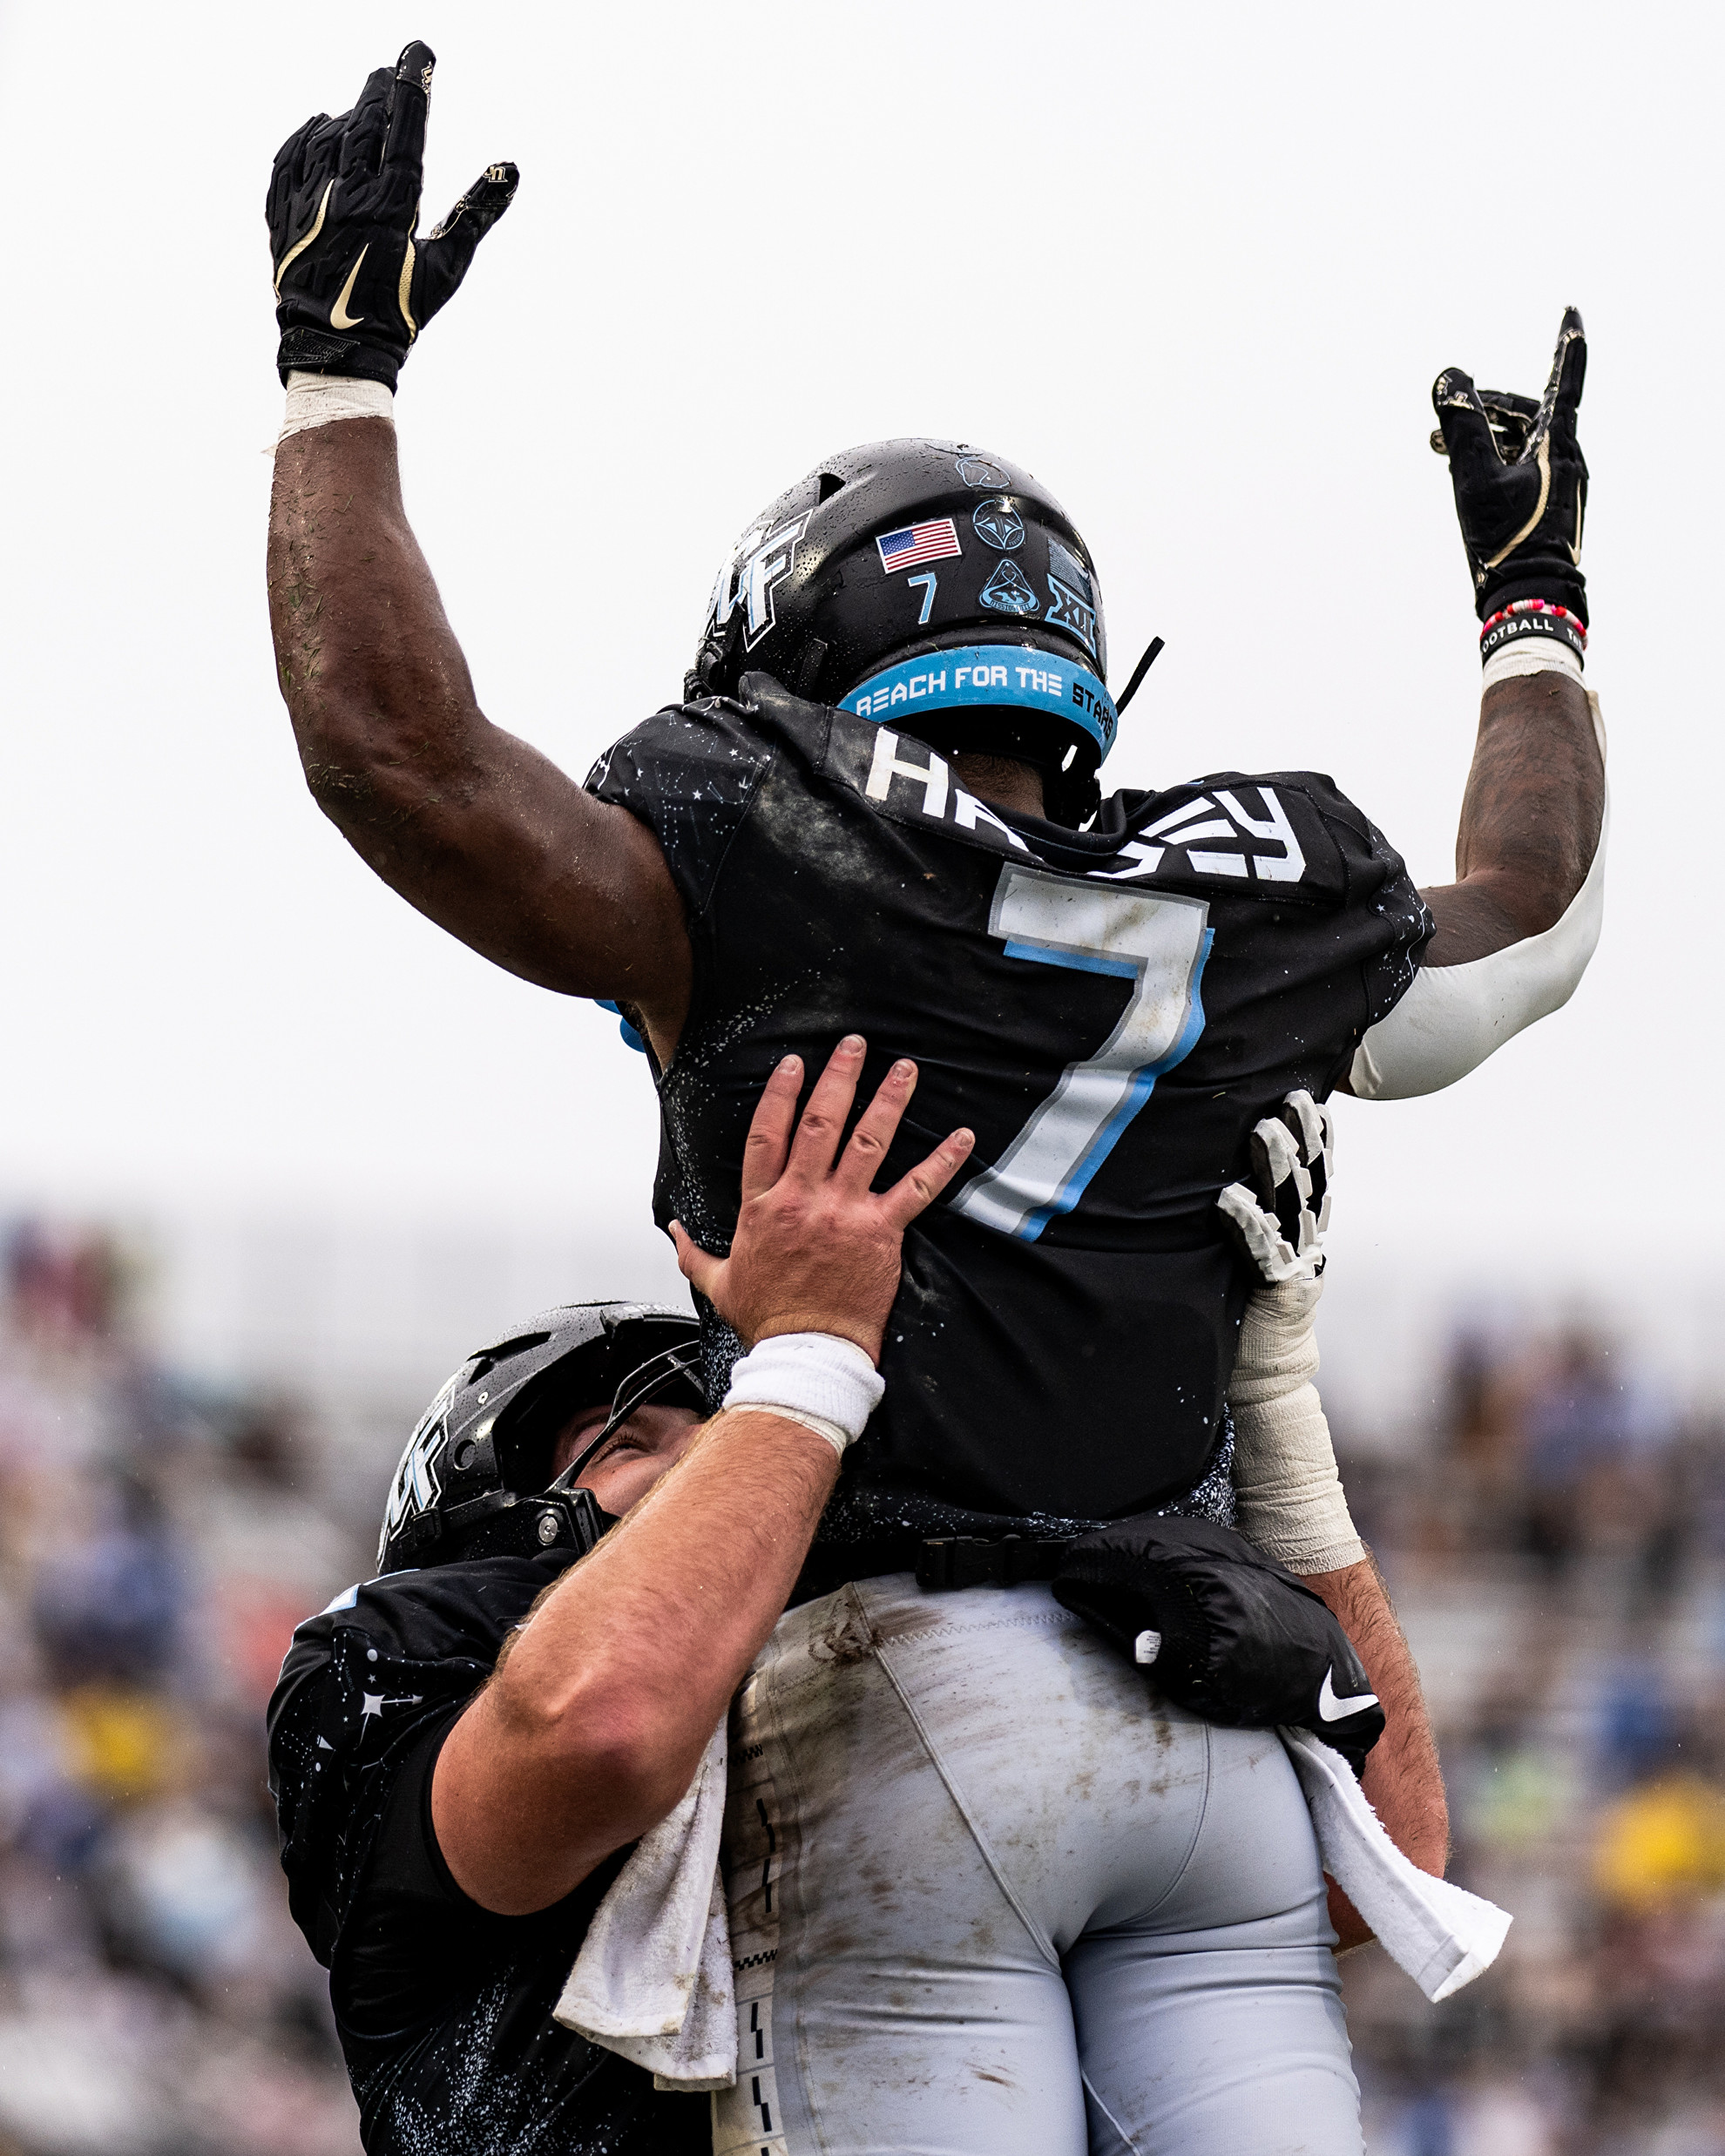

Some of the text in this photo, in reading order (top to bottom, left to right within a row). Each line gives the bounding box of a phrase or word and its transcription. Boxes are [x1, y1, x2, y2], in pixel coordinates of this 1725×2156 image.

[907, 571, 937, 625] 7
[1481, 618, 1554, 653] OOTBALL
[856, 665, 1114, 740] REACH FOR THE STARS
[948, 861, 1215, 1243] 7
